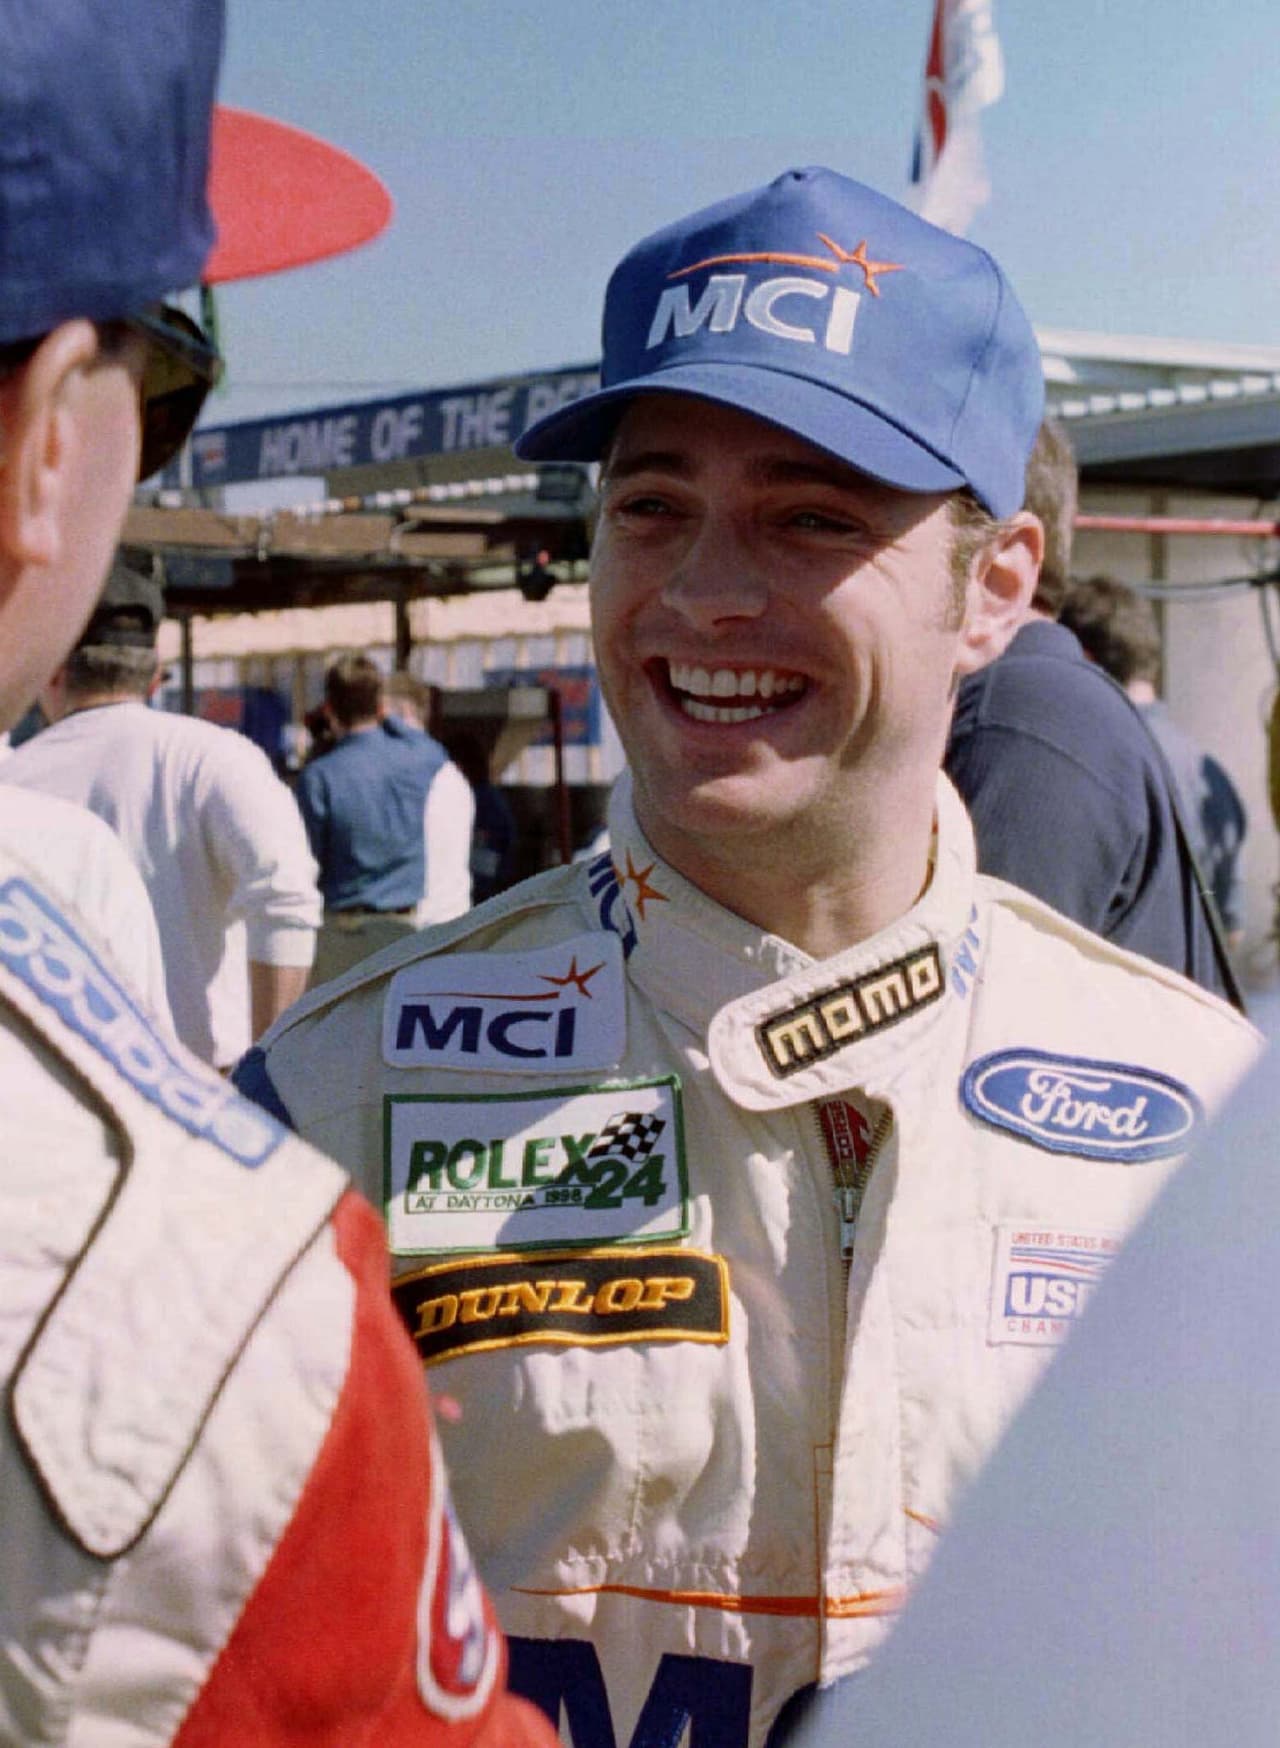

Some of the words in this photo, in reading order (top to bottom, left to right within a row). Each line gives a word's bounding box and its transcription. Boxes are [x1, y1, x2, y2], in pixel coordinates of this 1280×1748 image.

[645, 274, 860, 355] MCI
[258, 415, 357, 475] HOME
[370, 405, 424, 462] OF
[440, 387, 514, 453] THE
[396, 1004, 577, 1058] MCI
[1022, 1069, 1149, 1136] Ford
[408, 1133, 597, 1193] ROLEX
[584, 1155, 667, 1209] 24
[415, 1196, 437, 1209] AT
[446, 1193, 535, 1209] DAYTONA
[1011, 1232, 1052, 1245] UNITED
[414, 1277, 696, 1338] DUNLOP
[1010, 1276, 1086, 1318] US
